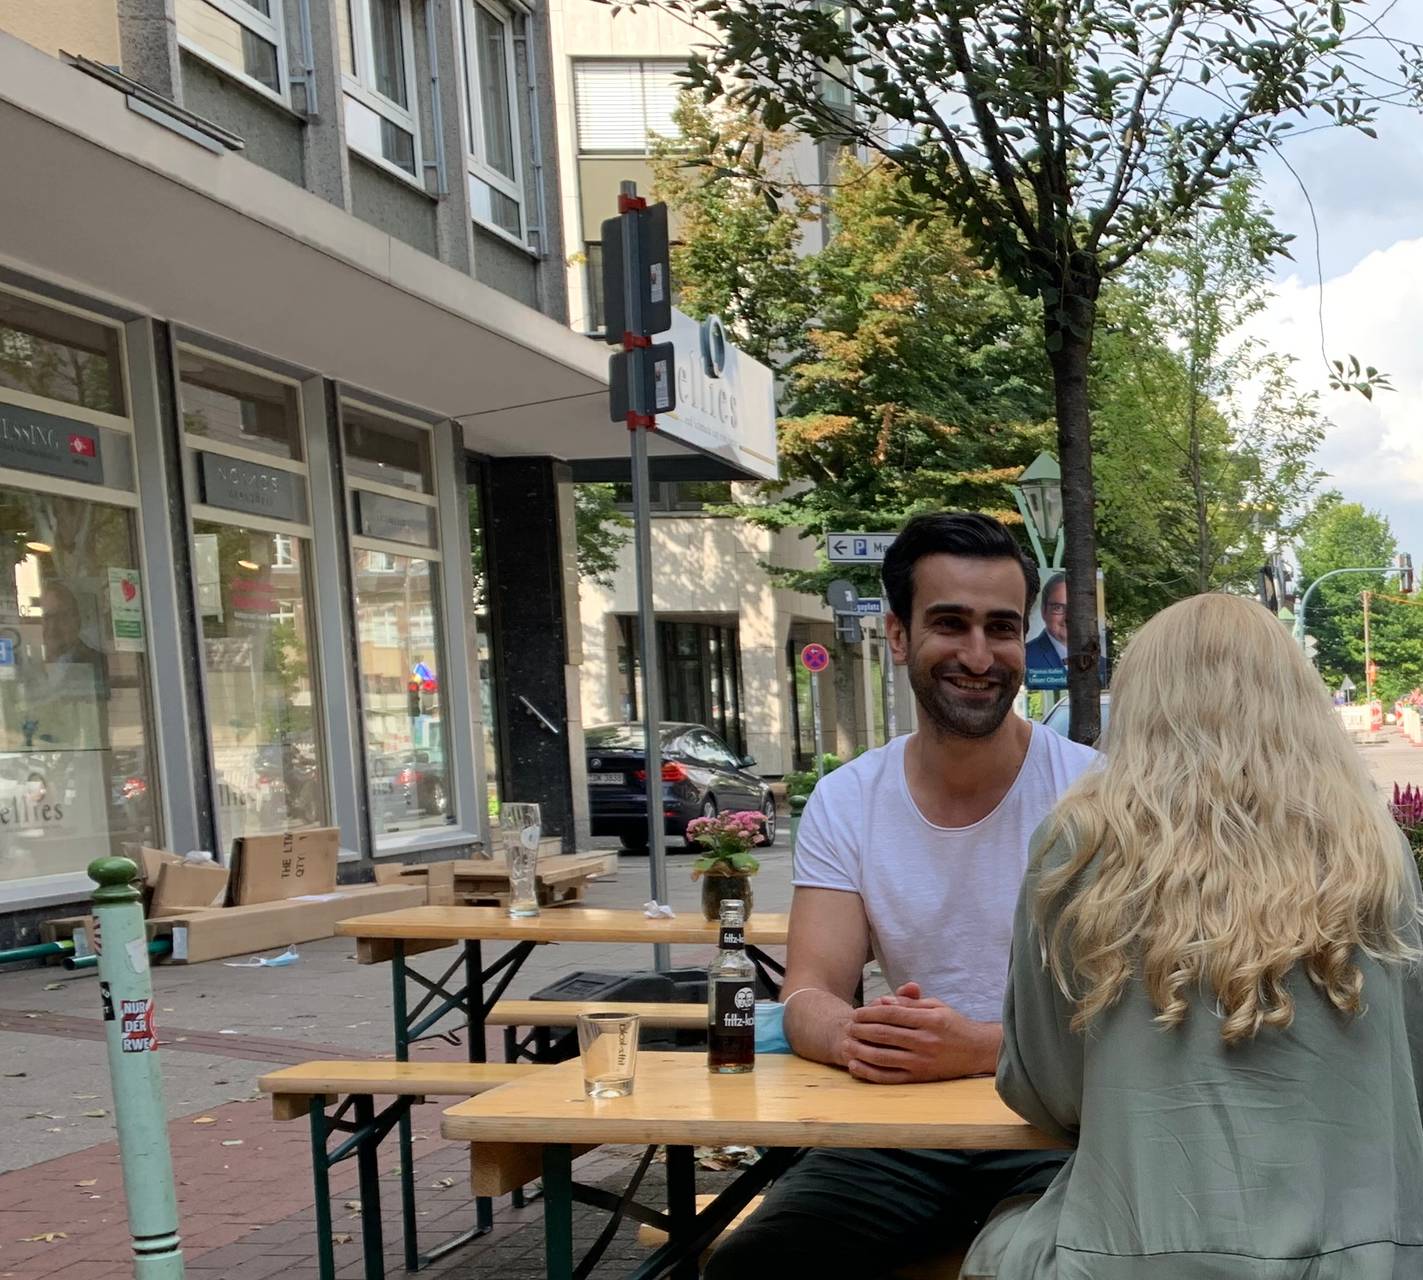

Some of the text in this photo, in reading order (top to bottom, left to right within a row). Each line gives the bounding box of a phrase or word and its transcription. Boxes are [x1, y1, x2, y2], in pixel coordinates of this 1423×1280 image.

[281, 858, 292, 879] THE
[295, 856, 305, 878] QTY
[124, 1002, 146, 1014] NUR
[125, 1020, 146, 1032] DER
[124, 1038, 150, 1051] RWE
